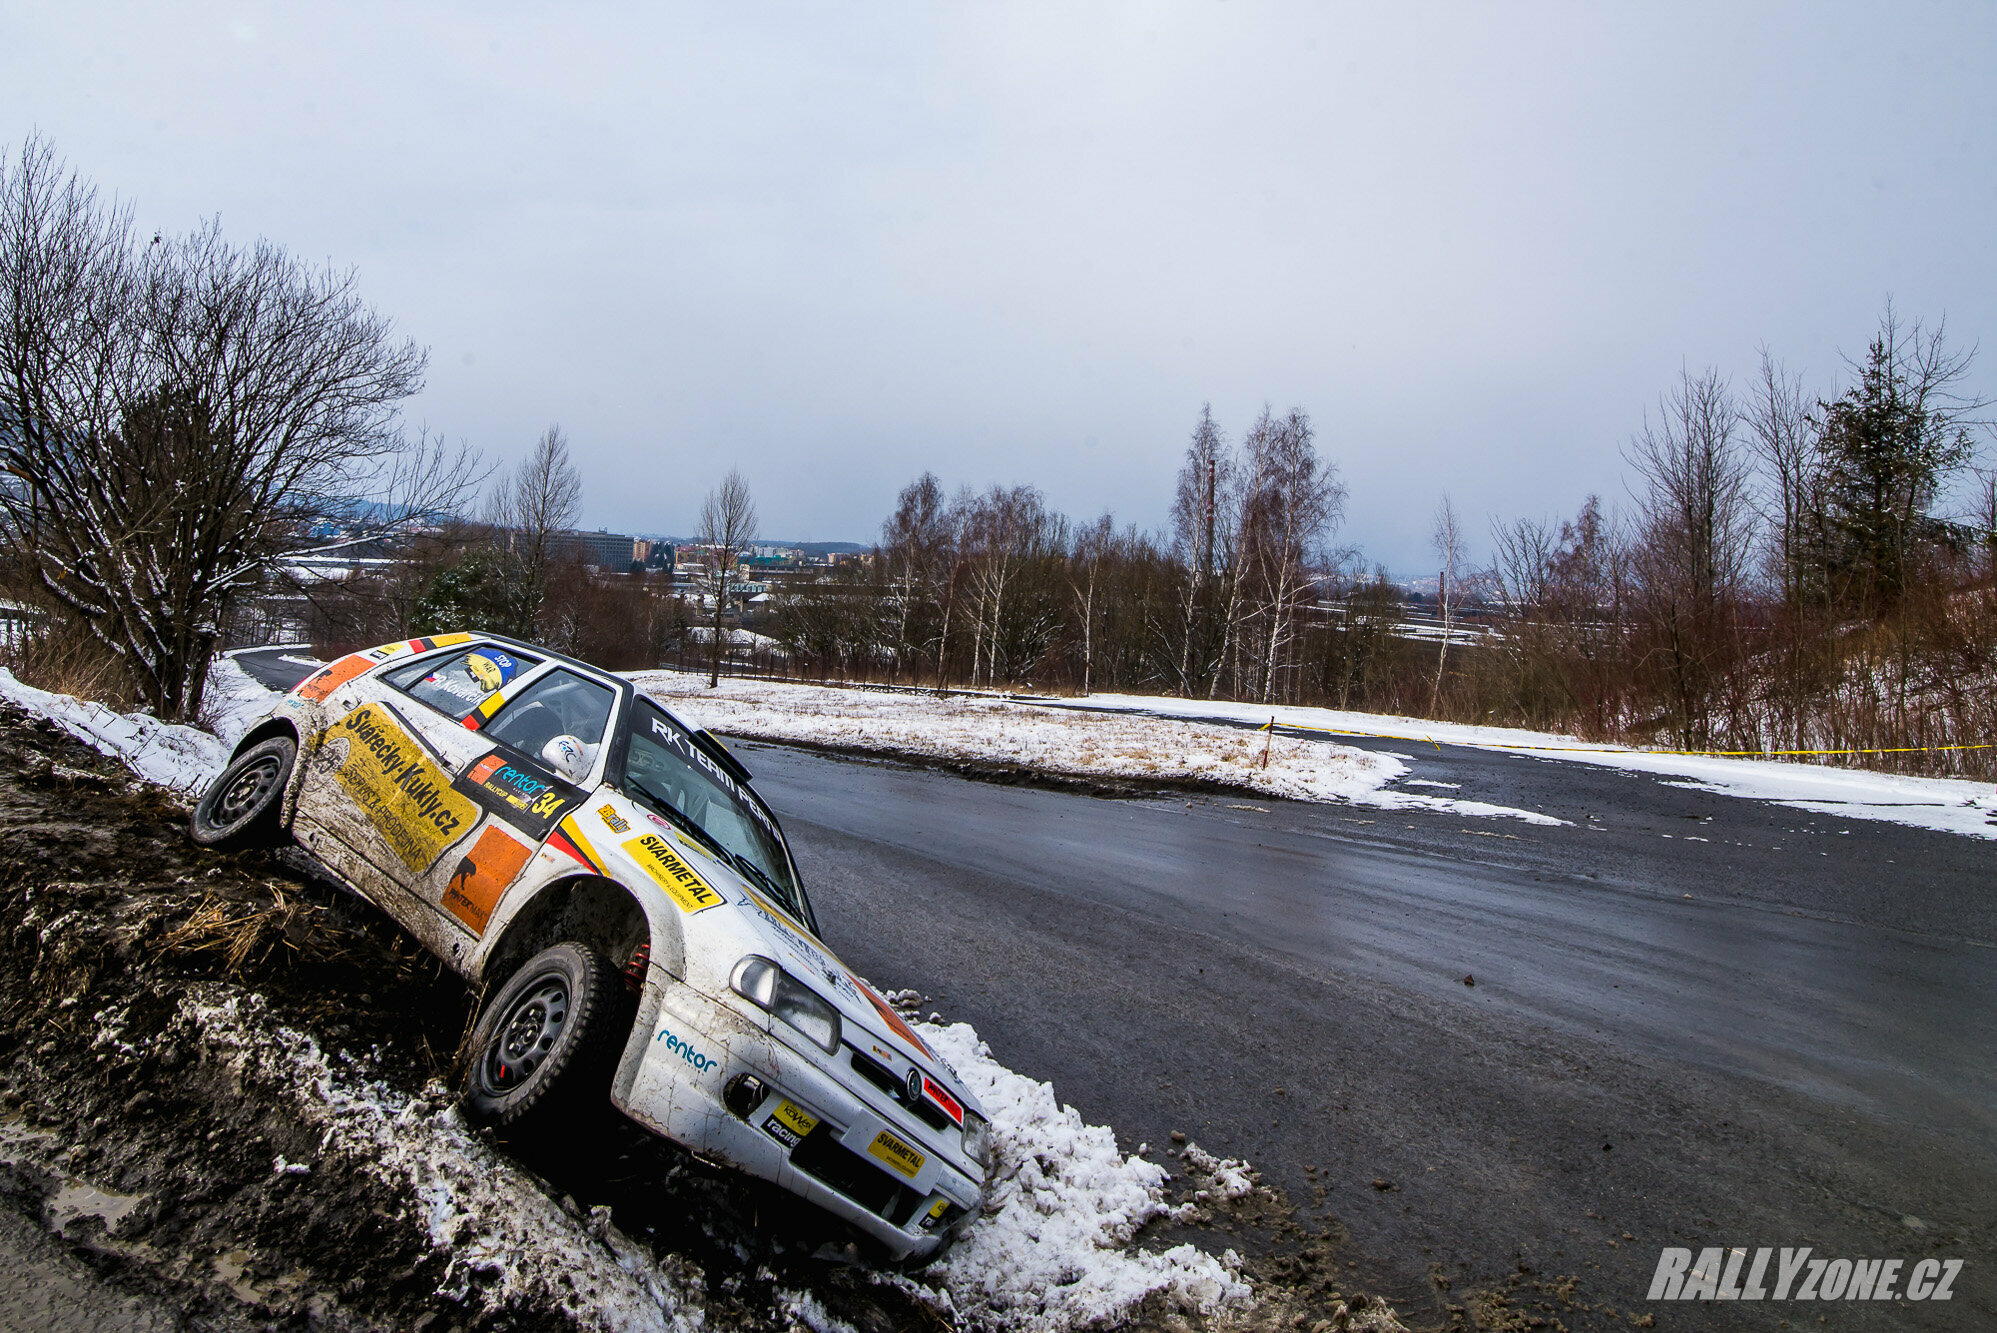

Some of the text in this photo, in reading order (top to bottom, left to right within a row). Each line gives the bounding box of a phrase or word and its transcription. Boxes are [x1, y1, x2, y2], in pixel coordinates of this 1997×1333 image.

[494, 654, 512, 668] STOP
[651, 717, 685, 756] RK
[684, 738, 735, 793] TEAM
[494, 766, 546, 795] rentor
[532, 792, 565, 820] 34
[640, 836, 712, 903] SVARMETAL
[657, 1030, 718, 1073] rentor
[766, 1118, 801, 1148] racing
[877, 1133, 921, 1168] SVARMETAL
